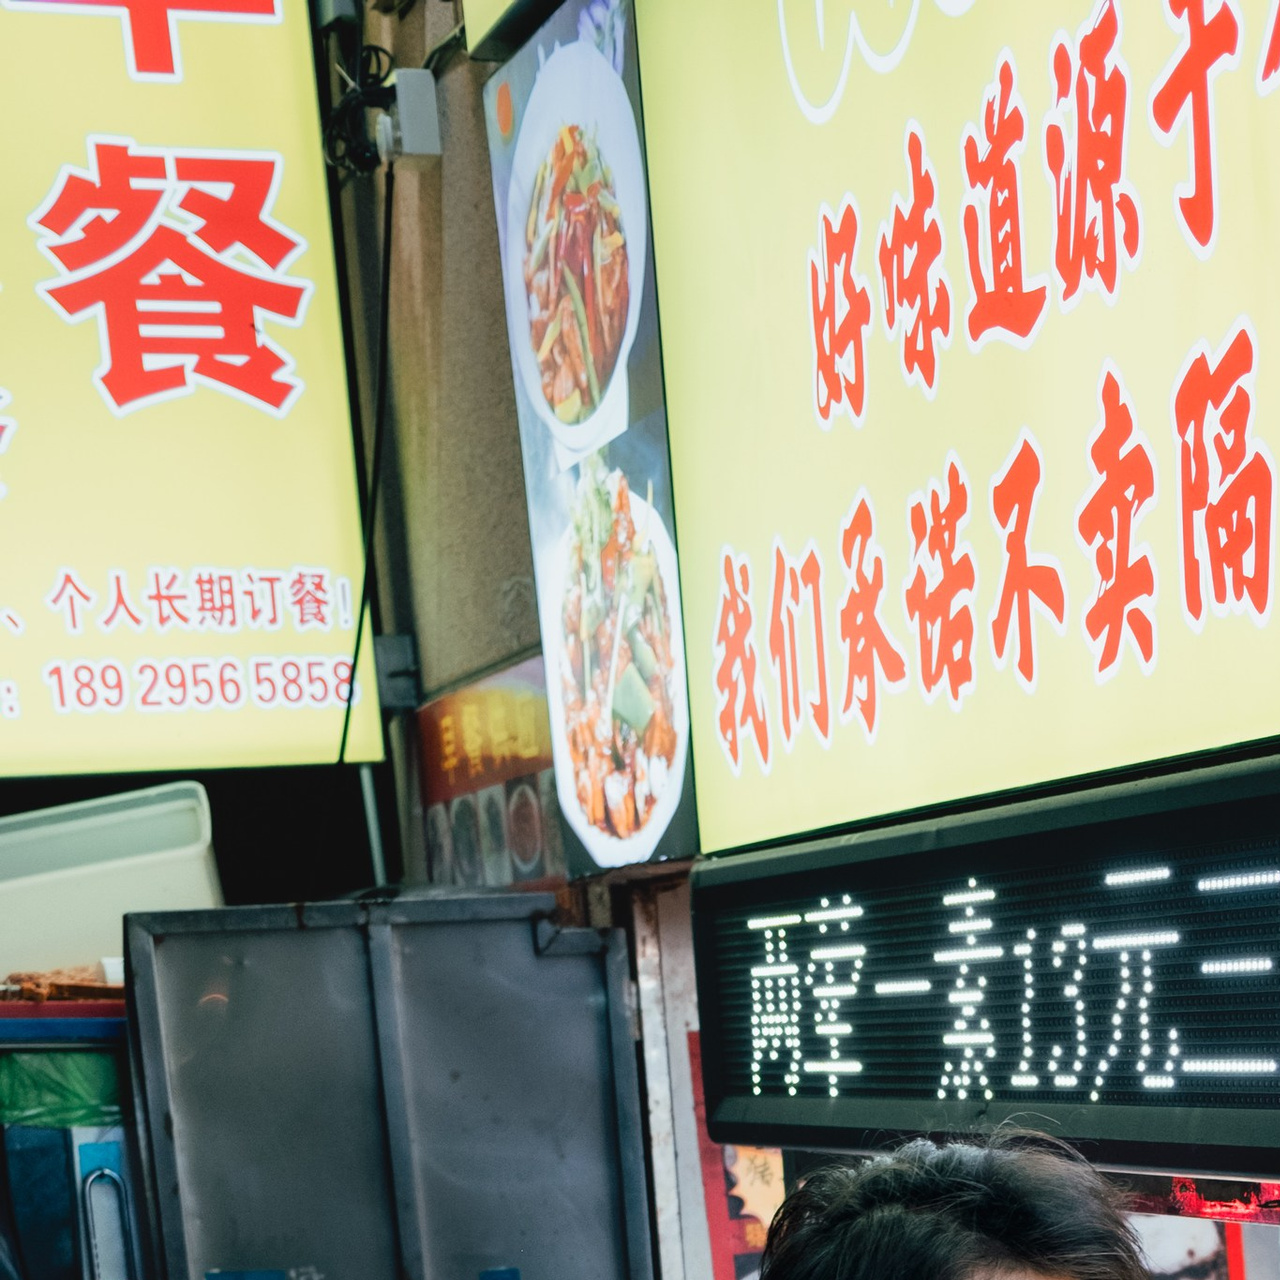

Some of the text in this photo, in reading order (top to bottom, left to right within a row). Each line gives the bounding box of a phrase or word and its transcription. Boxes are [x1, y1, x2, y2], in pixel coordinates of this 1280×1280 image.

[49, 660, 356, 707] 189 2956 5858
